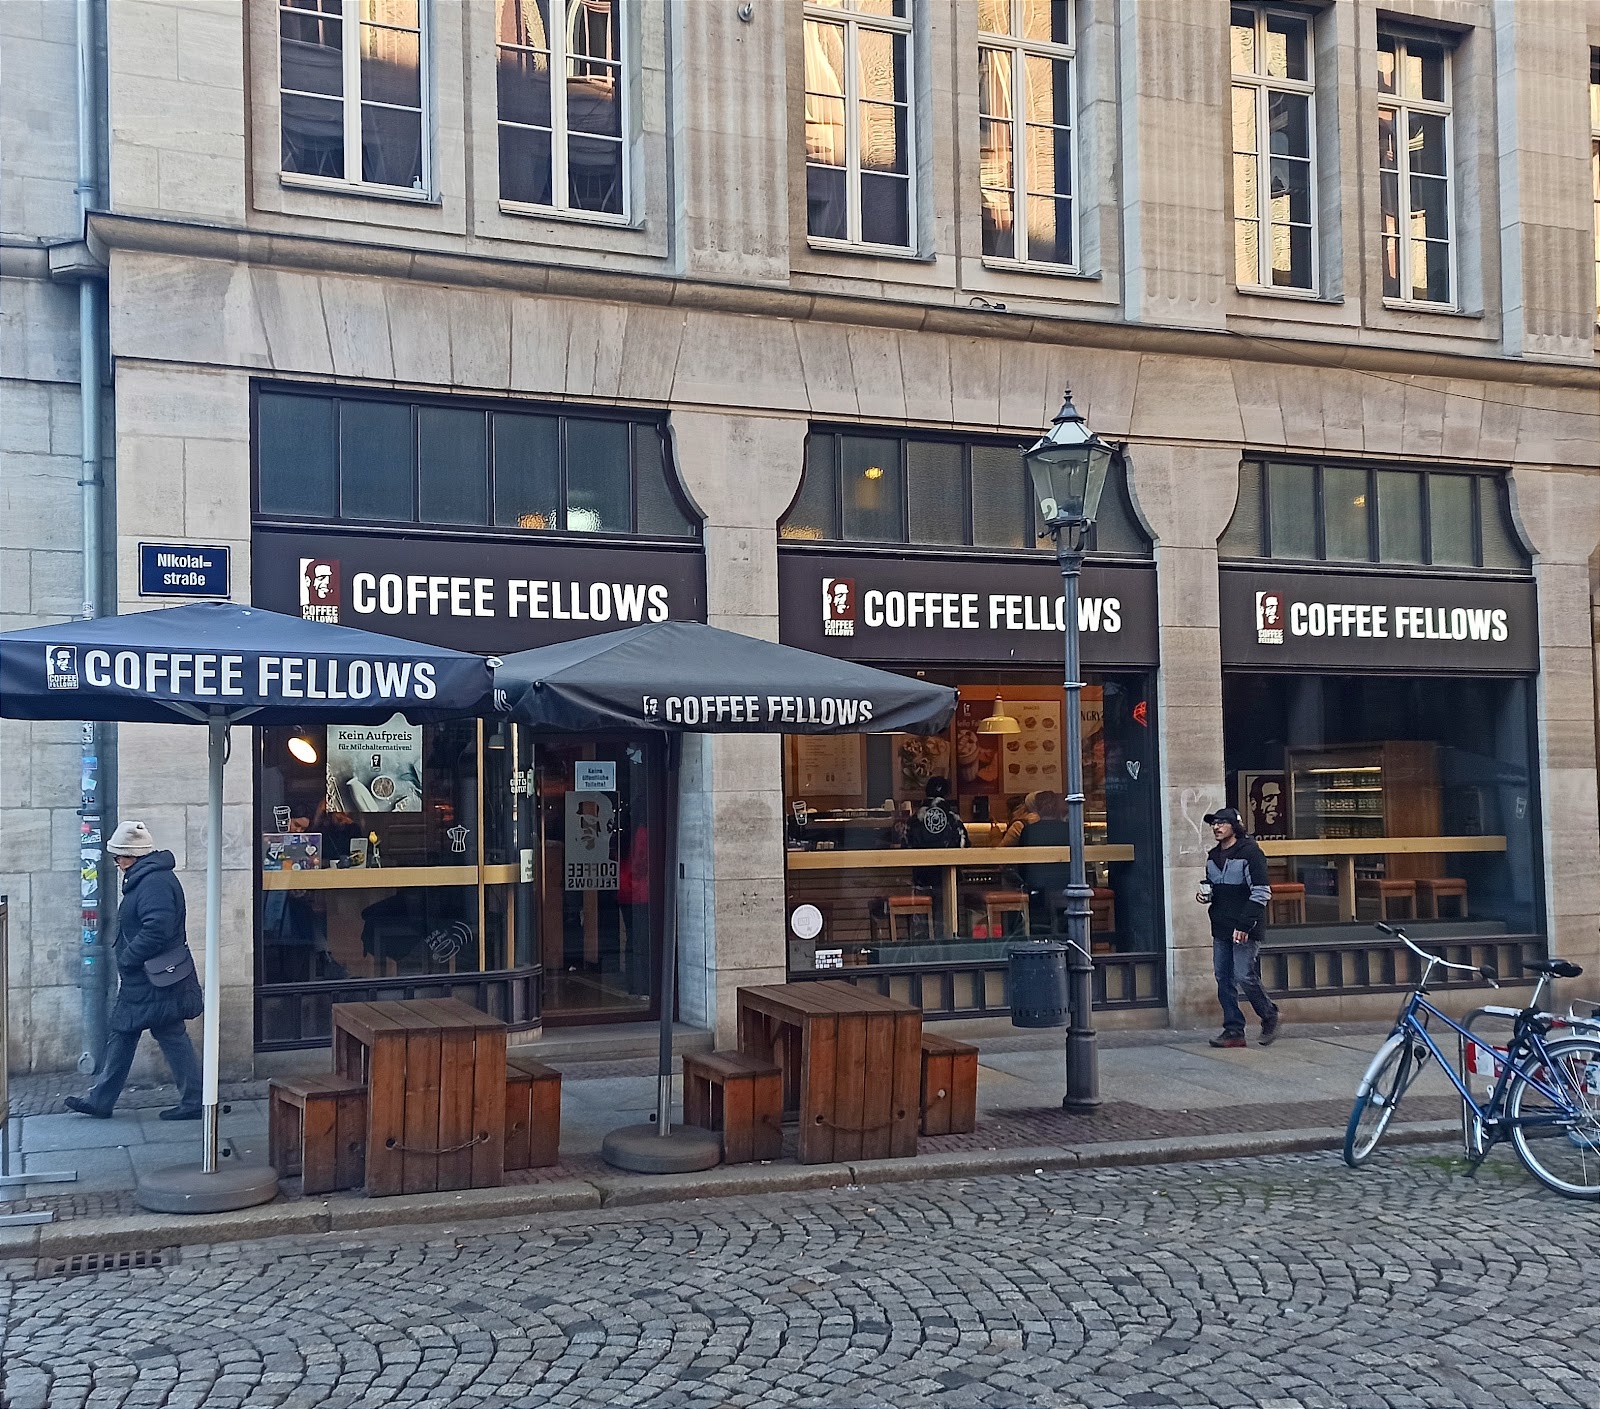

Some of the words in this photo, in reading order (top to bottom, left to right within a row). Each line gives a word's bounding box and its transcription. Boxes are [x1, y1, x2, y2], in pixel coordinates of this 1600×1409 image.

[163, 572, 206, 586] straße
[352, 572, 495, 617] COFFEE
[508, 579, 669, 623] FELLOWS
[302, 605, 338, 615] COFFEE
[864, 589, 979, 629] COFFEE
[824, 620, 854, 629] COFFEE
[1290, 602, 1389, 638] COFFEE
[1395, 606, 1508, 642] FELLOWS
[1258, 629, 1284, 638] COFFEE
[50, 674, 77, 682] COFFEE
[85, 650, 244, 695] COFFEE
[258, 656, 437, 699] FELLOWS
[665, 695, 760, 725] COFFEE
[766, 695, 874, 726] FELLOWS
[338, 730, 364, 741] Kein
[365, 730, 412, 743] Aufpreis
[338, 743, 349, 751] für
[350, 743, 412, 752] Milchalternativen!
